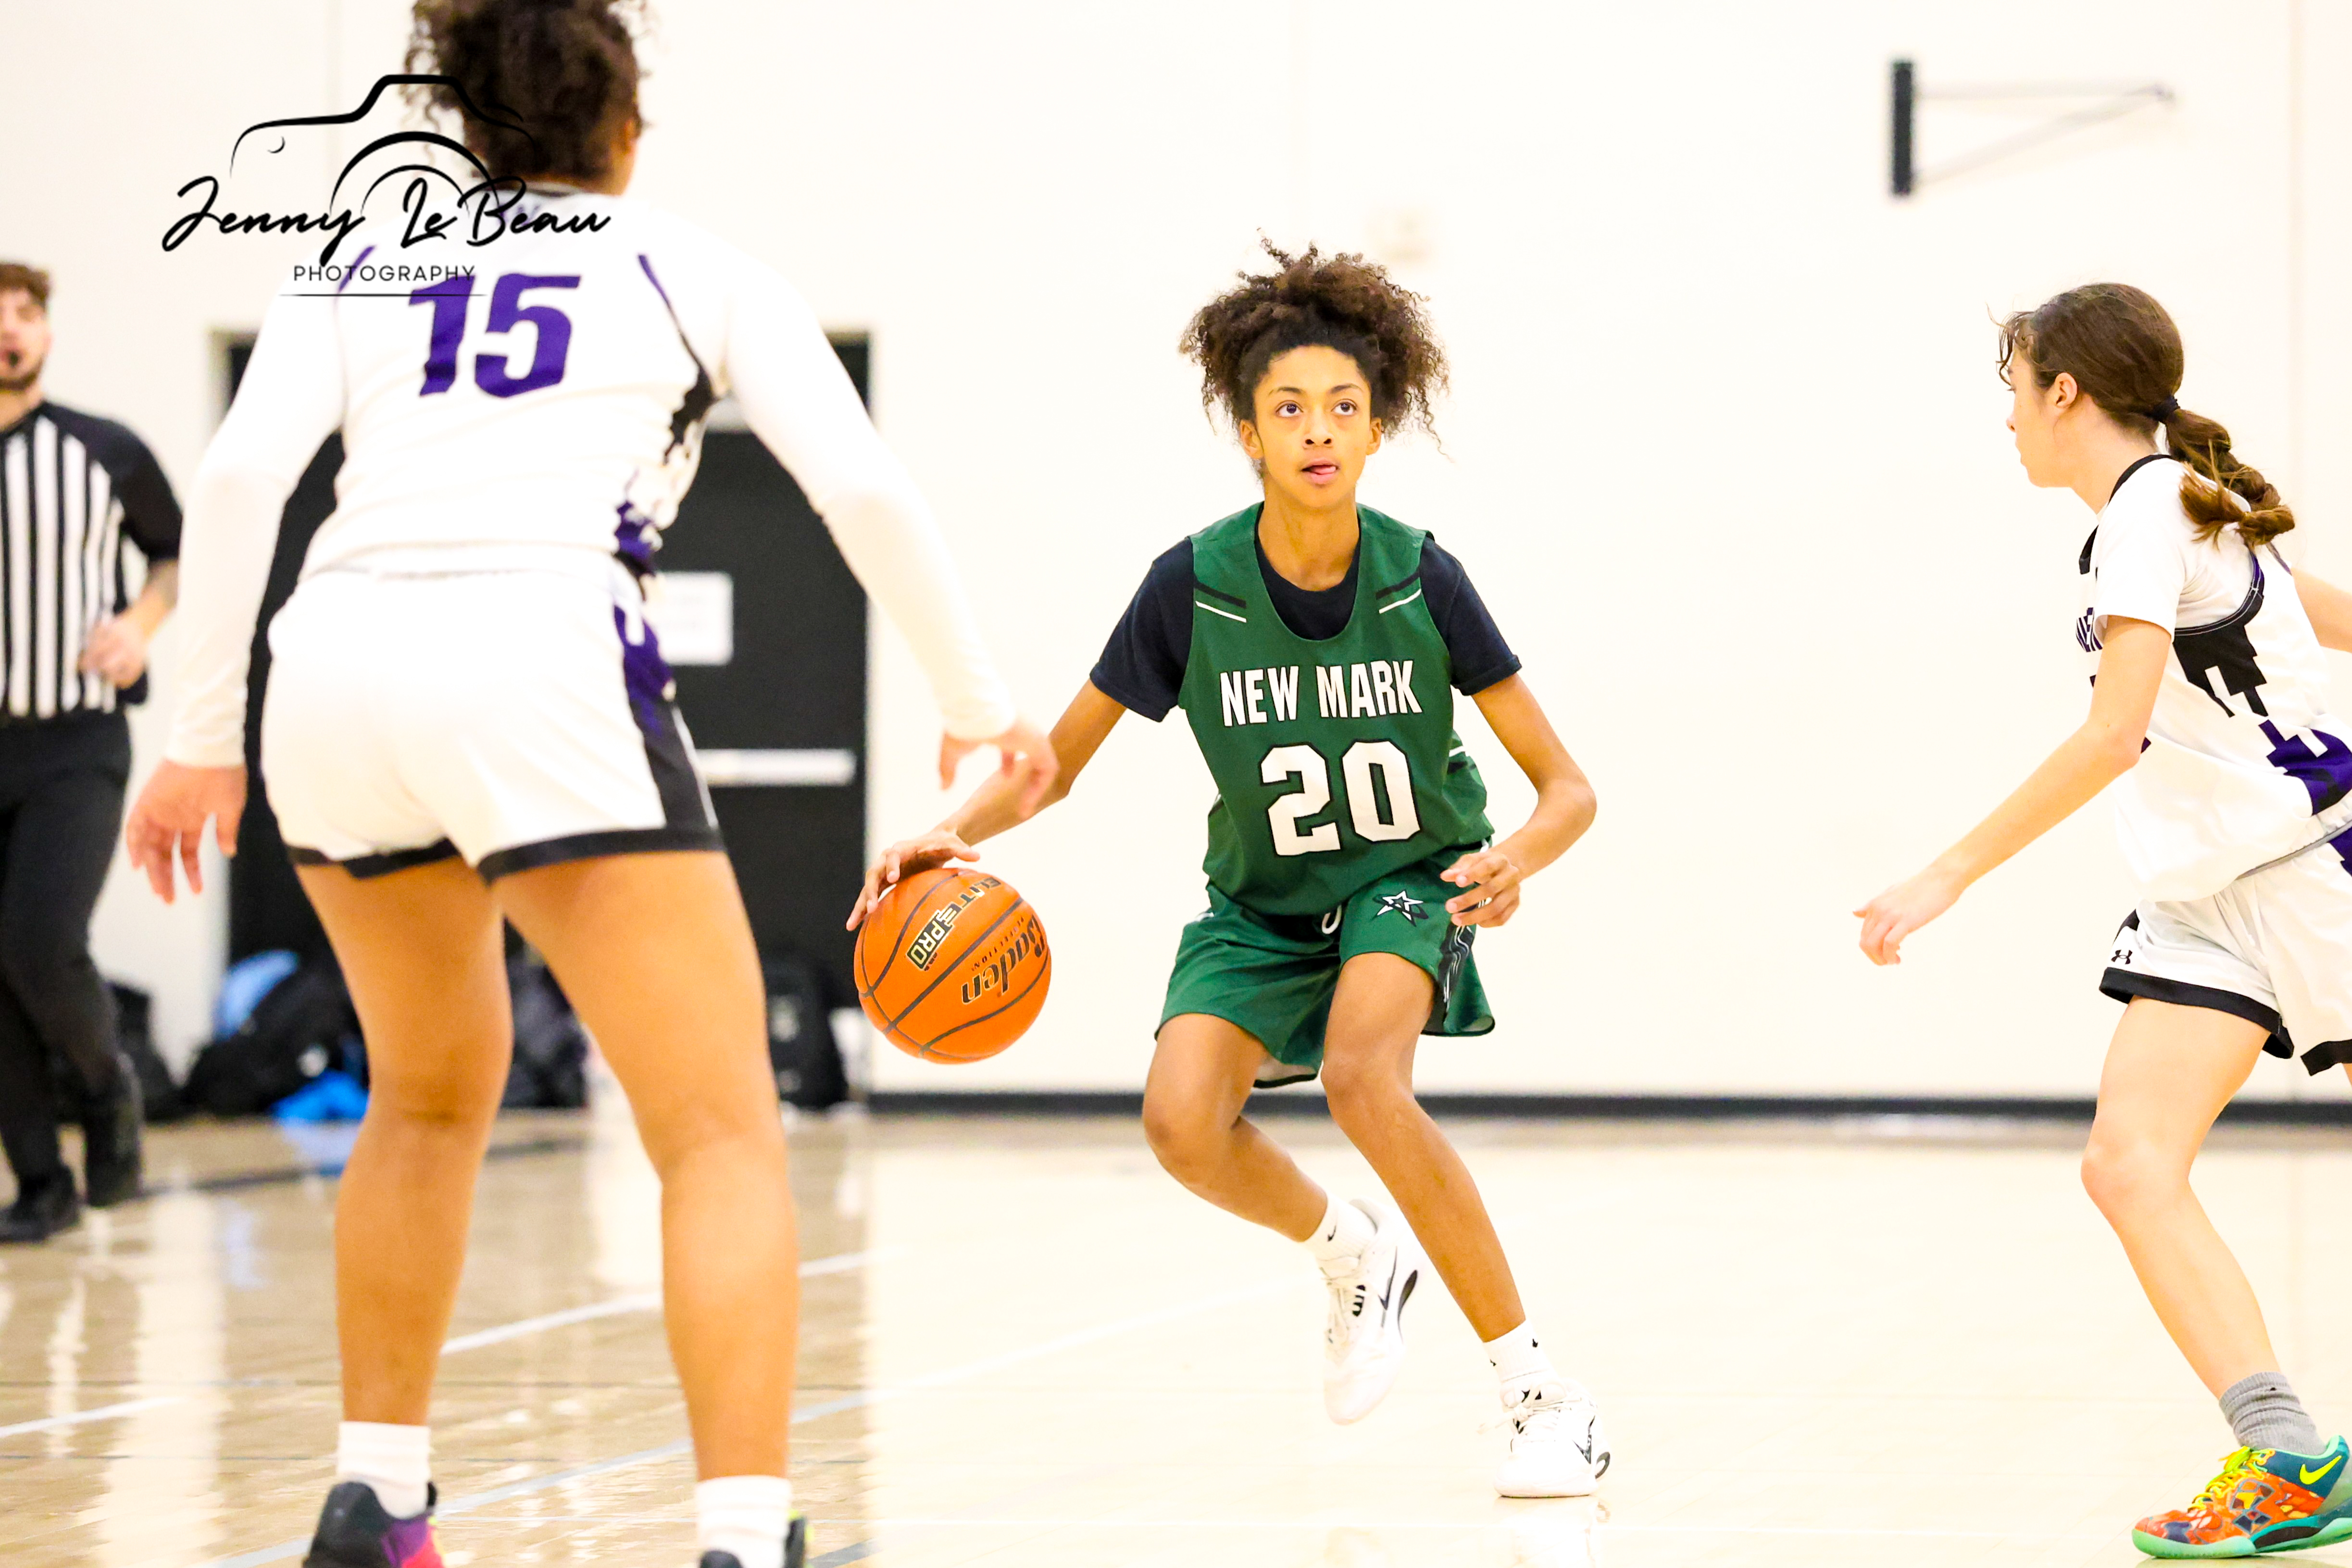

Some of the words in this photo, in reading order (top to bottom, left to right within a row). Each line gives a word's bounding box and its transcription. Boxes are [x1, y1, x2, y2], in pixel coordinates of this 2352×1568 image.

[408, 273, 581, 399] 15
[1219, 665, 1299, 727] NEW
[1315, 659, 1423, 718] MARK
[1259, 739, 1422, 857] 20
[962, 914, 1045, 1005] Baden
